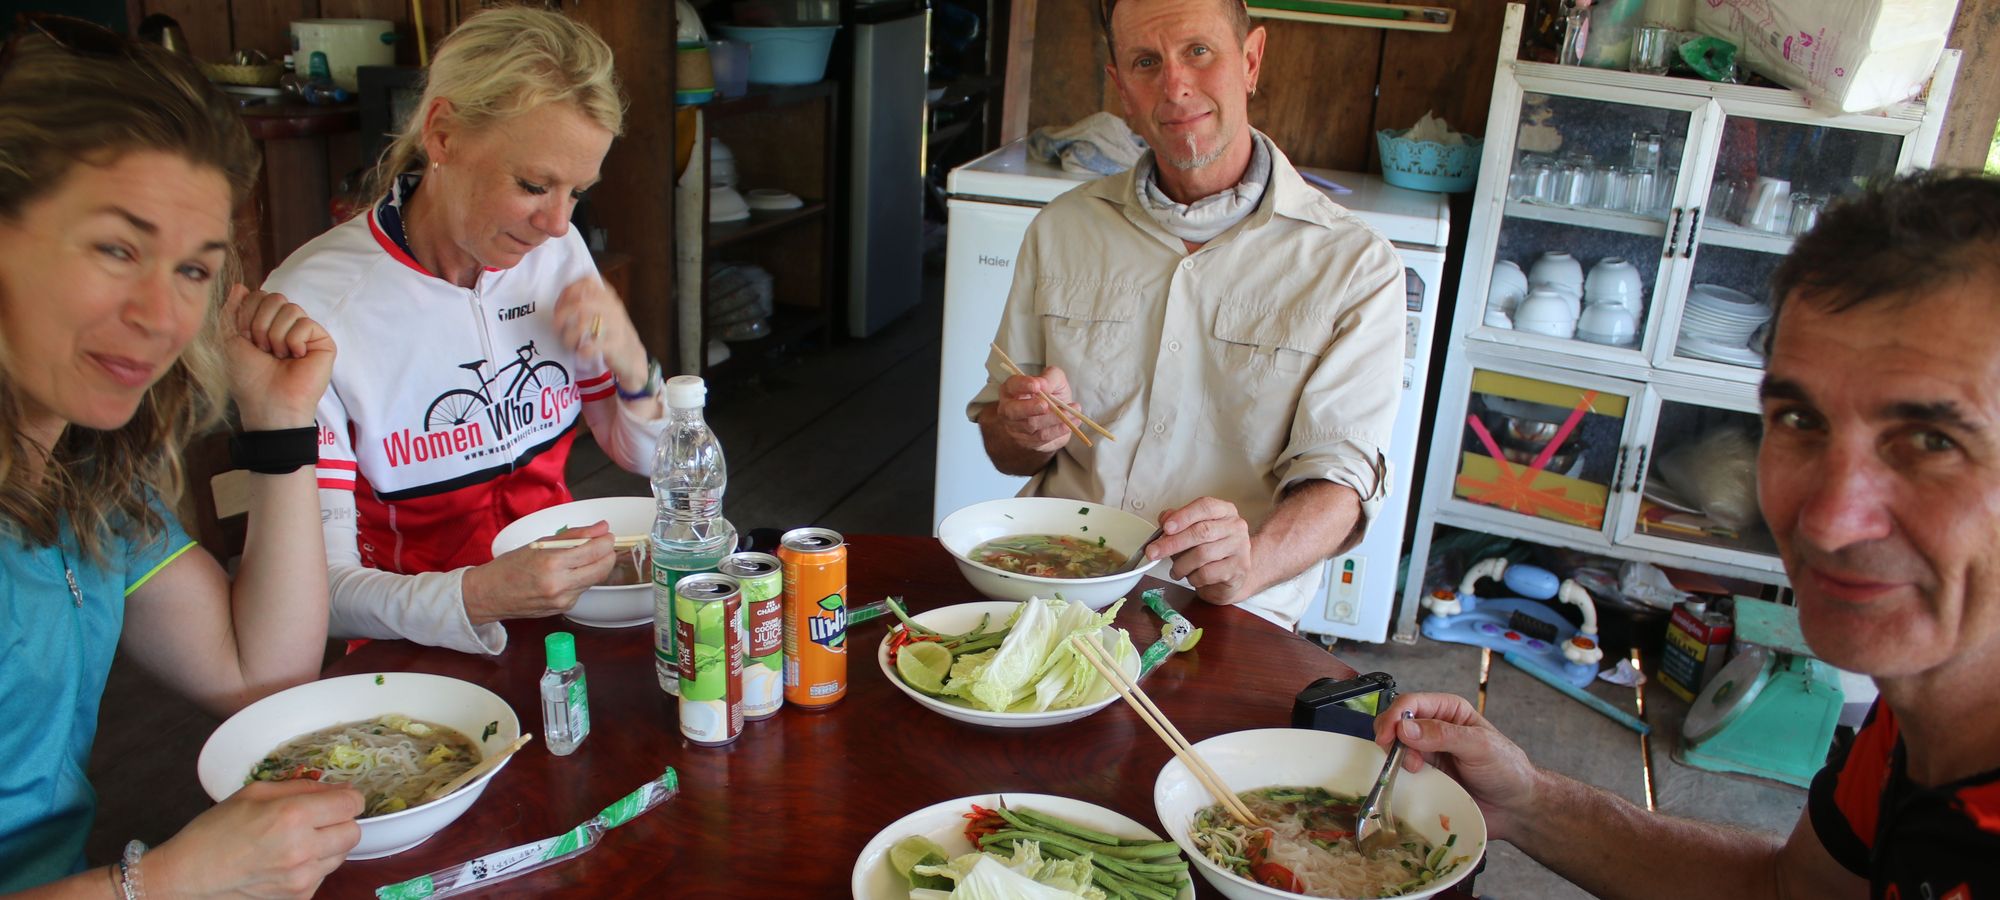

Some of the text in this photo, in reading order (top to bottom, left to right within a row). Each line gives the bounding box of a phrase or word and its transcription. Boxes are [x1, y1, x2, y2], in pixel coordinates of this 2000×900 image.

[978, 255, 1010, 268] Haier
[382, 421, 484, 468] Women
[486, 396, 534, 441] Who
